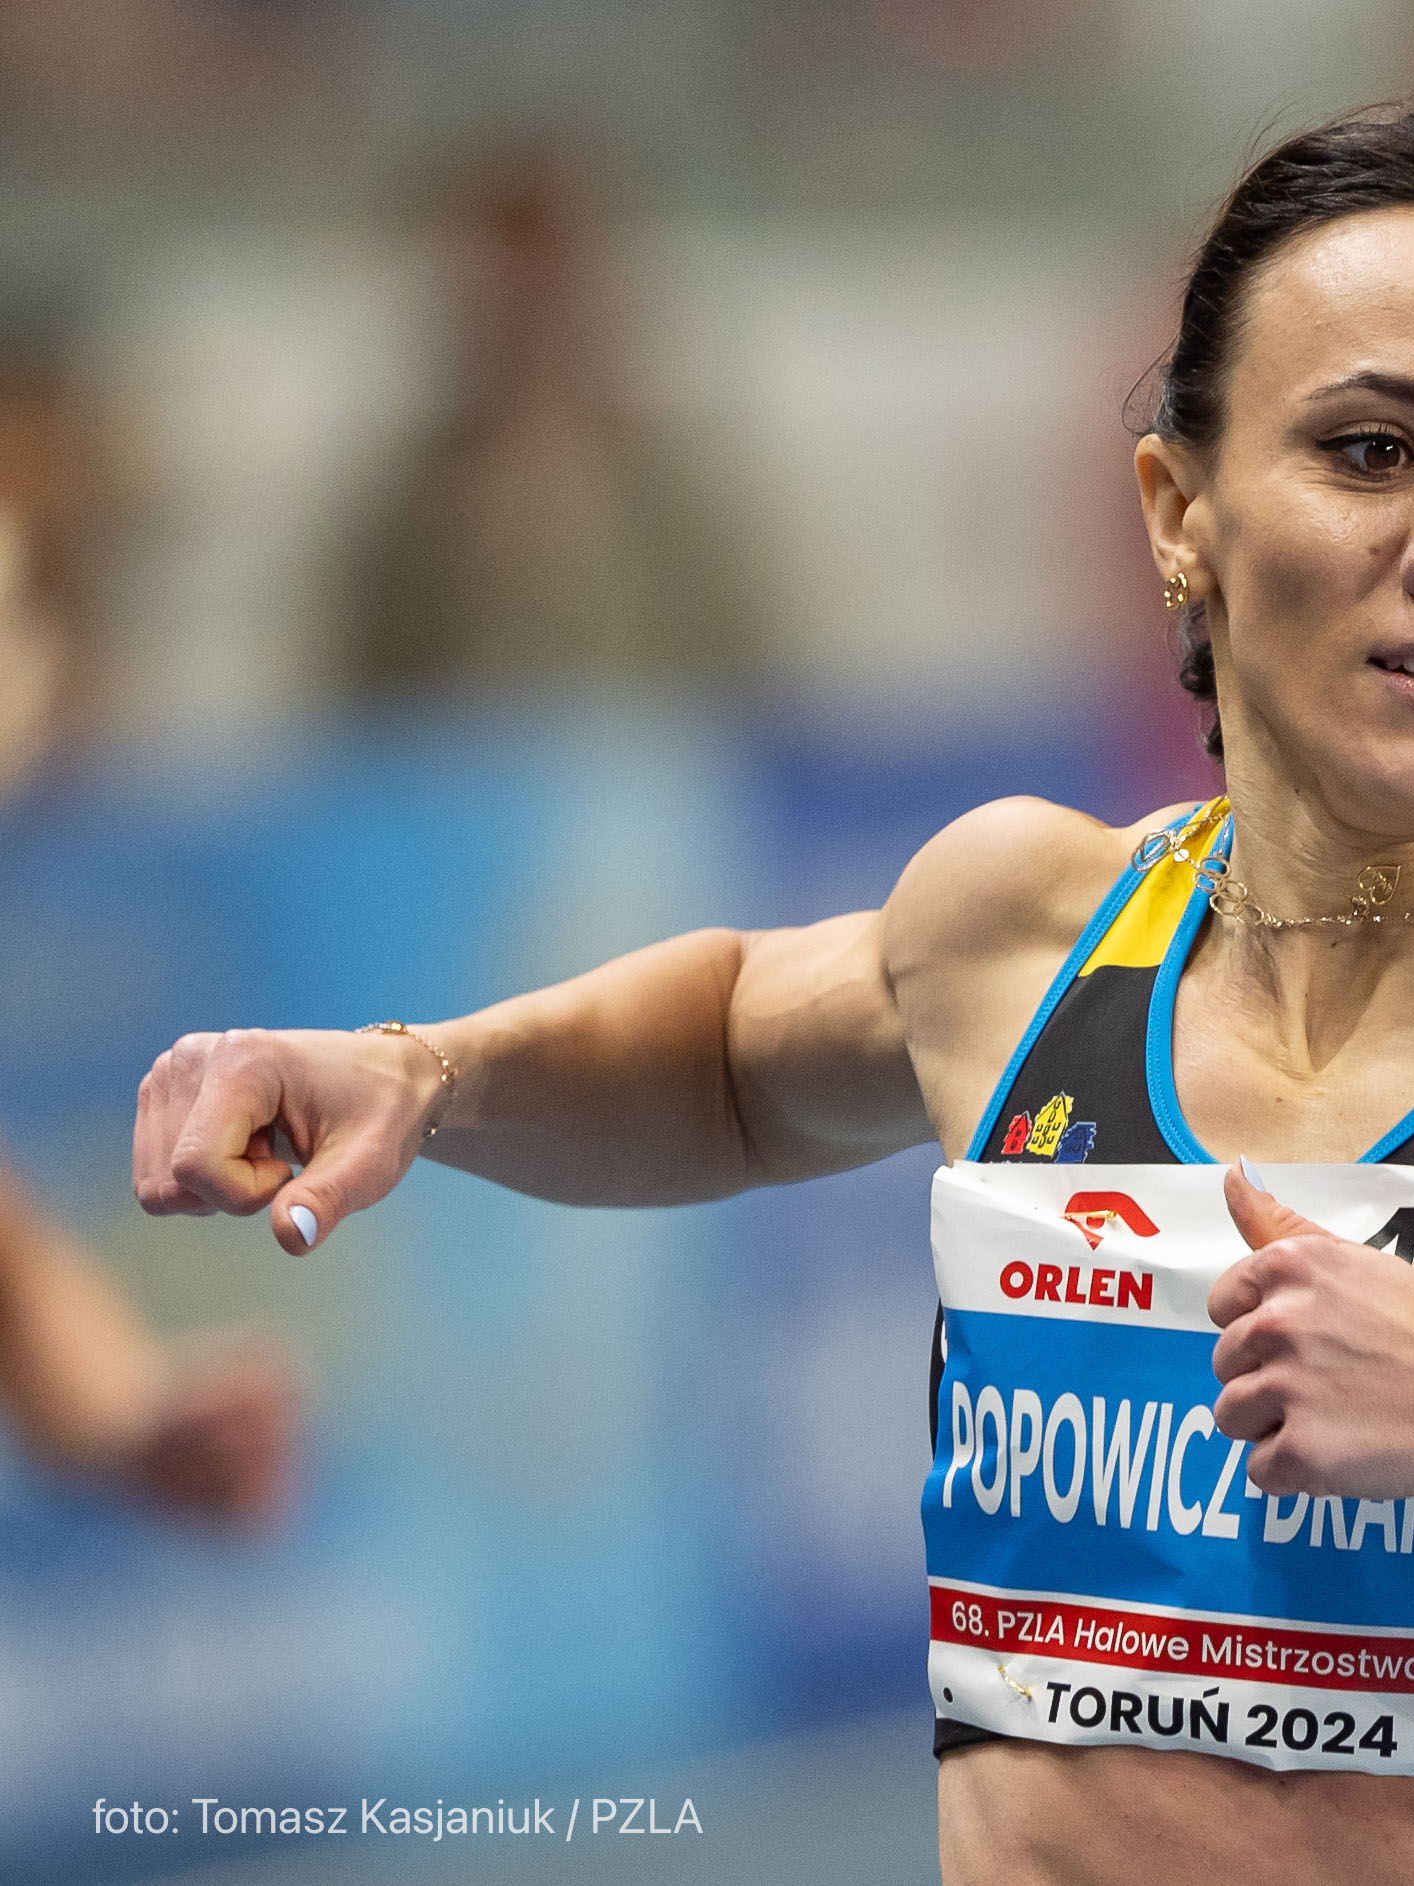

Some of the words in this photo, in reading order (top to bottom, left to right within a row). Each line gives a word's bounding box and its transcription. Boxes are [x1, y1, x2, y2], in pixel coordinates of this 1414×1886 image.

[999, 1261, 1153, 1310] ORLEN
[952, 1600, 990, 1637] 68.
[997, 1610, 1065, 1645] PZLA
[1073, 1618, 1189, 1661] Halowe
[1046, 1681, 1230, 1743] TORUŃ
[1245, 1704, 1398, 1758] 2024
